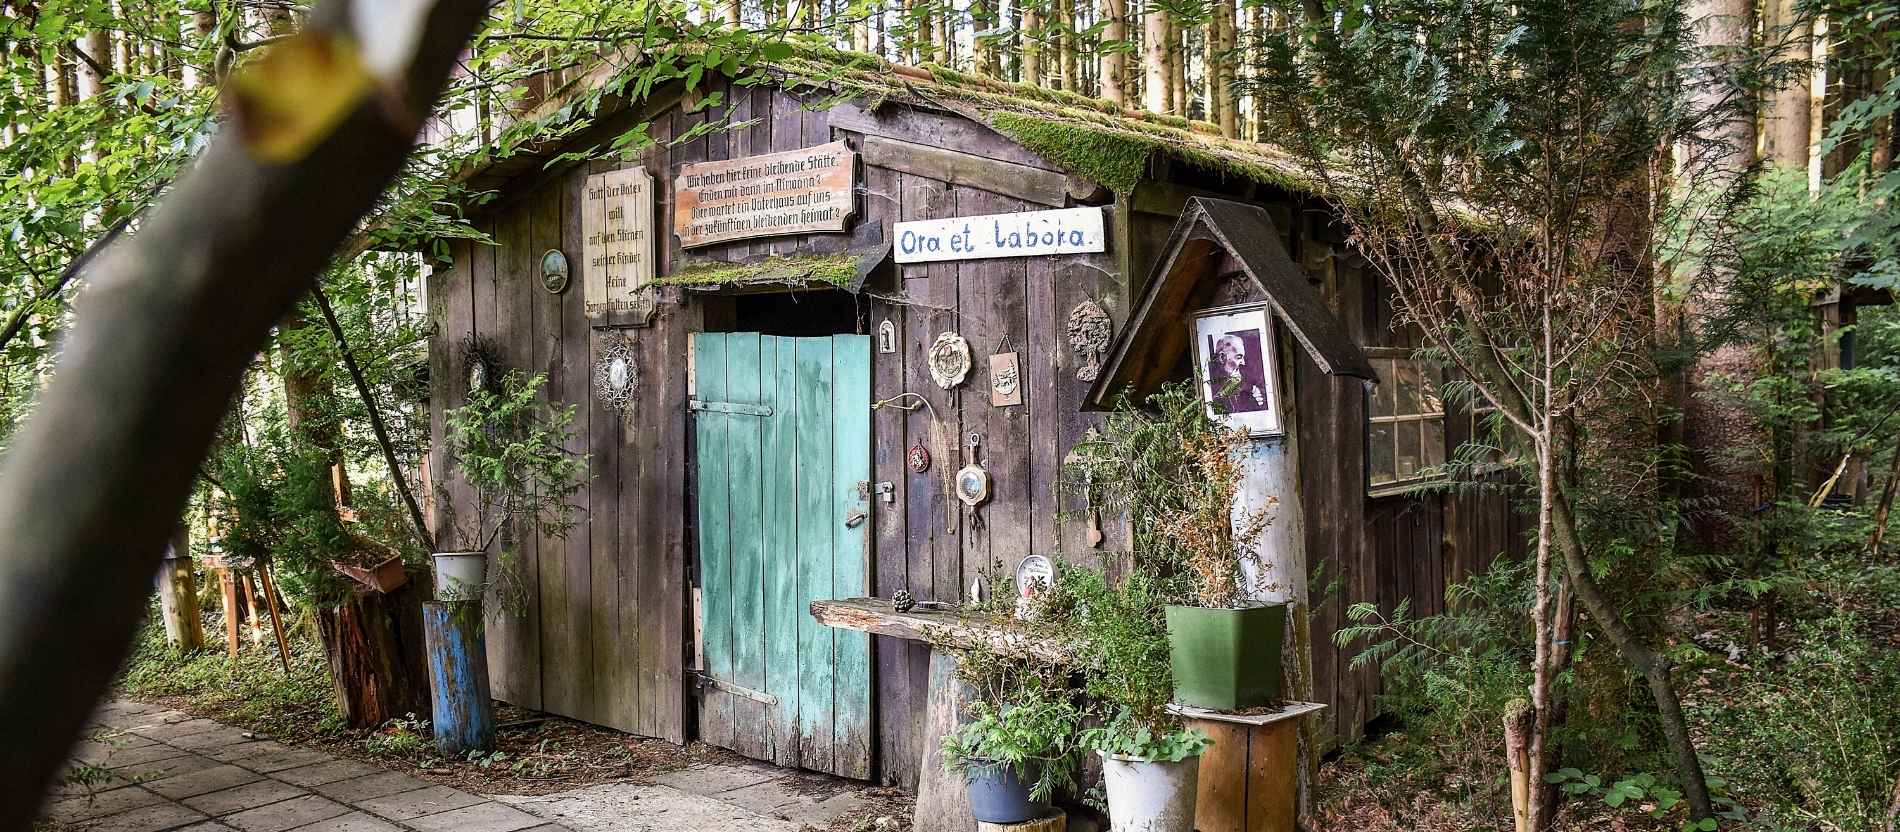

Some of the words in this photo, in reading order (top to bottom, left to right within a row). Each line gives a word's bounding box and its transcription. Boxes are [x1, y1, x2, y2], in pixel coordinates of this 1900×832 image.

[687, 174, 699, 188] Wir
[700, 172, 724, 187] haben
[727, 168, 740, 183] hier
[743, 166, 762, 180] keine
[765, 160, 805, 176] bleibende
[698, 190, 722, 202] Enden
[725, 187, 737, 198] wir
[741, 185, 760, 196] dann
[764, 181, 773, 193] im
[608, 206, 622, 220] will
[692, 207, 707, 219] Oder
[709, 201, 735, 216] wartet
[738, 201, 749, 212] ein
[752, 195, 795, 211] Vaterhaus
[797, 192, 811, 206] auf
[814, 192, 831, 202] uns
[683, 224, 689, 236] in
[692, 224, 702, 235] der
[753, 212, 798, 229] bleibenden
[589, 232, 600, 246] auf
[901, 230, 940, 254] Ora
[951, 224, 975, 252] et
